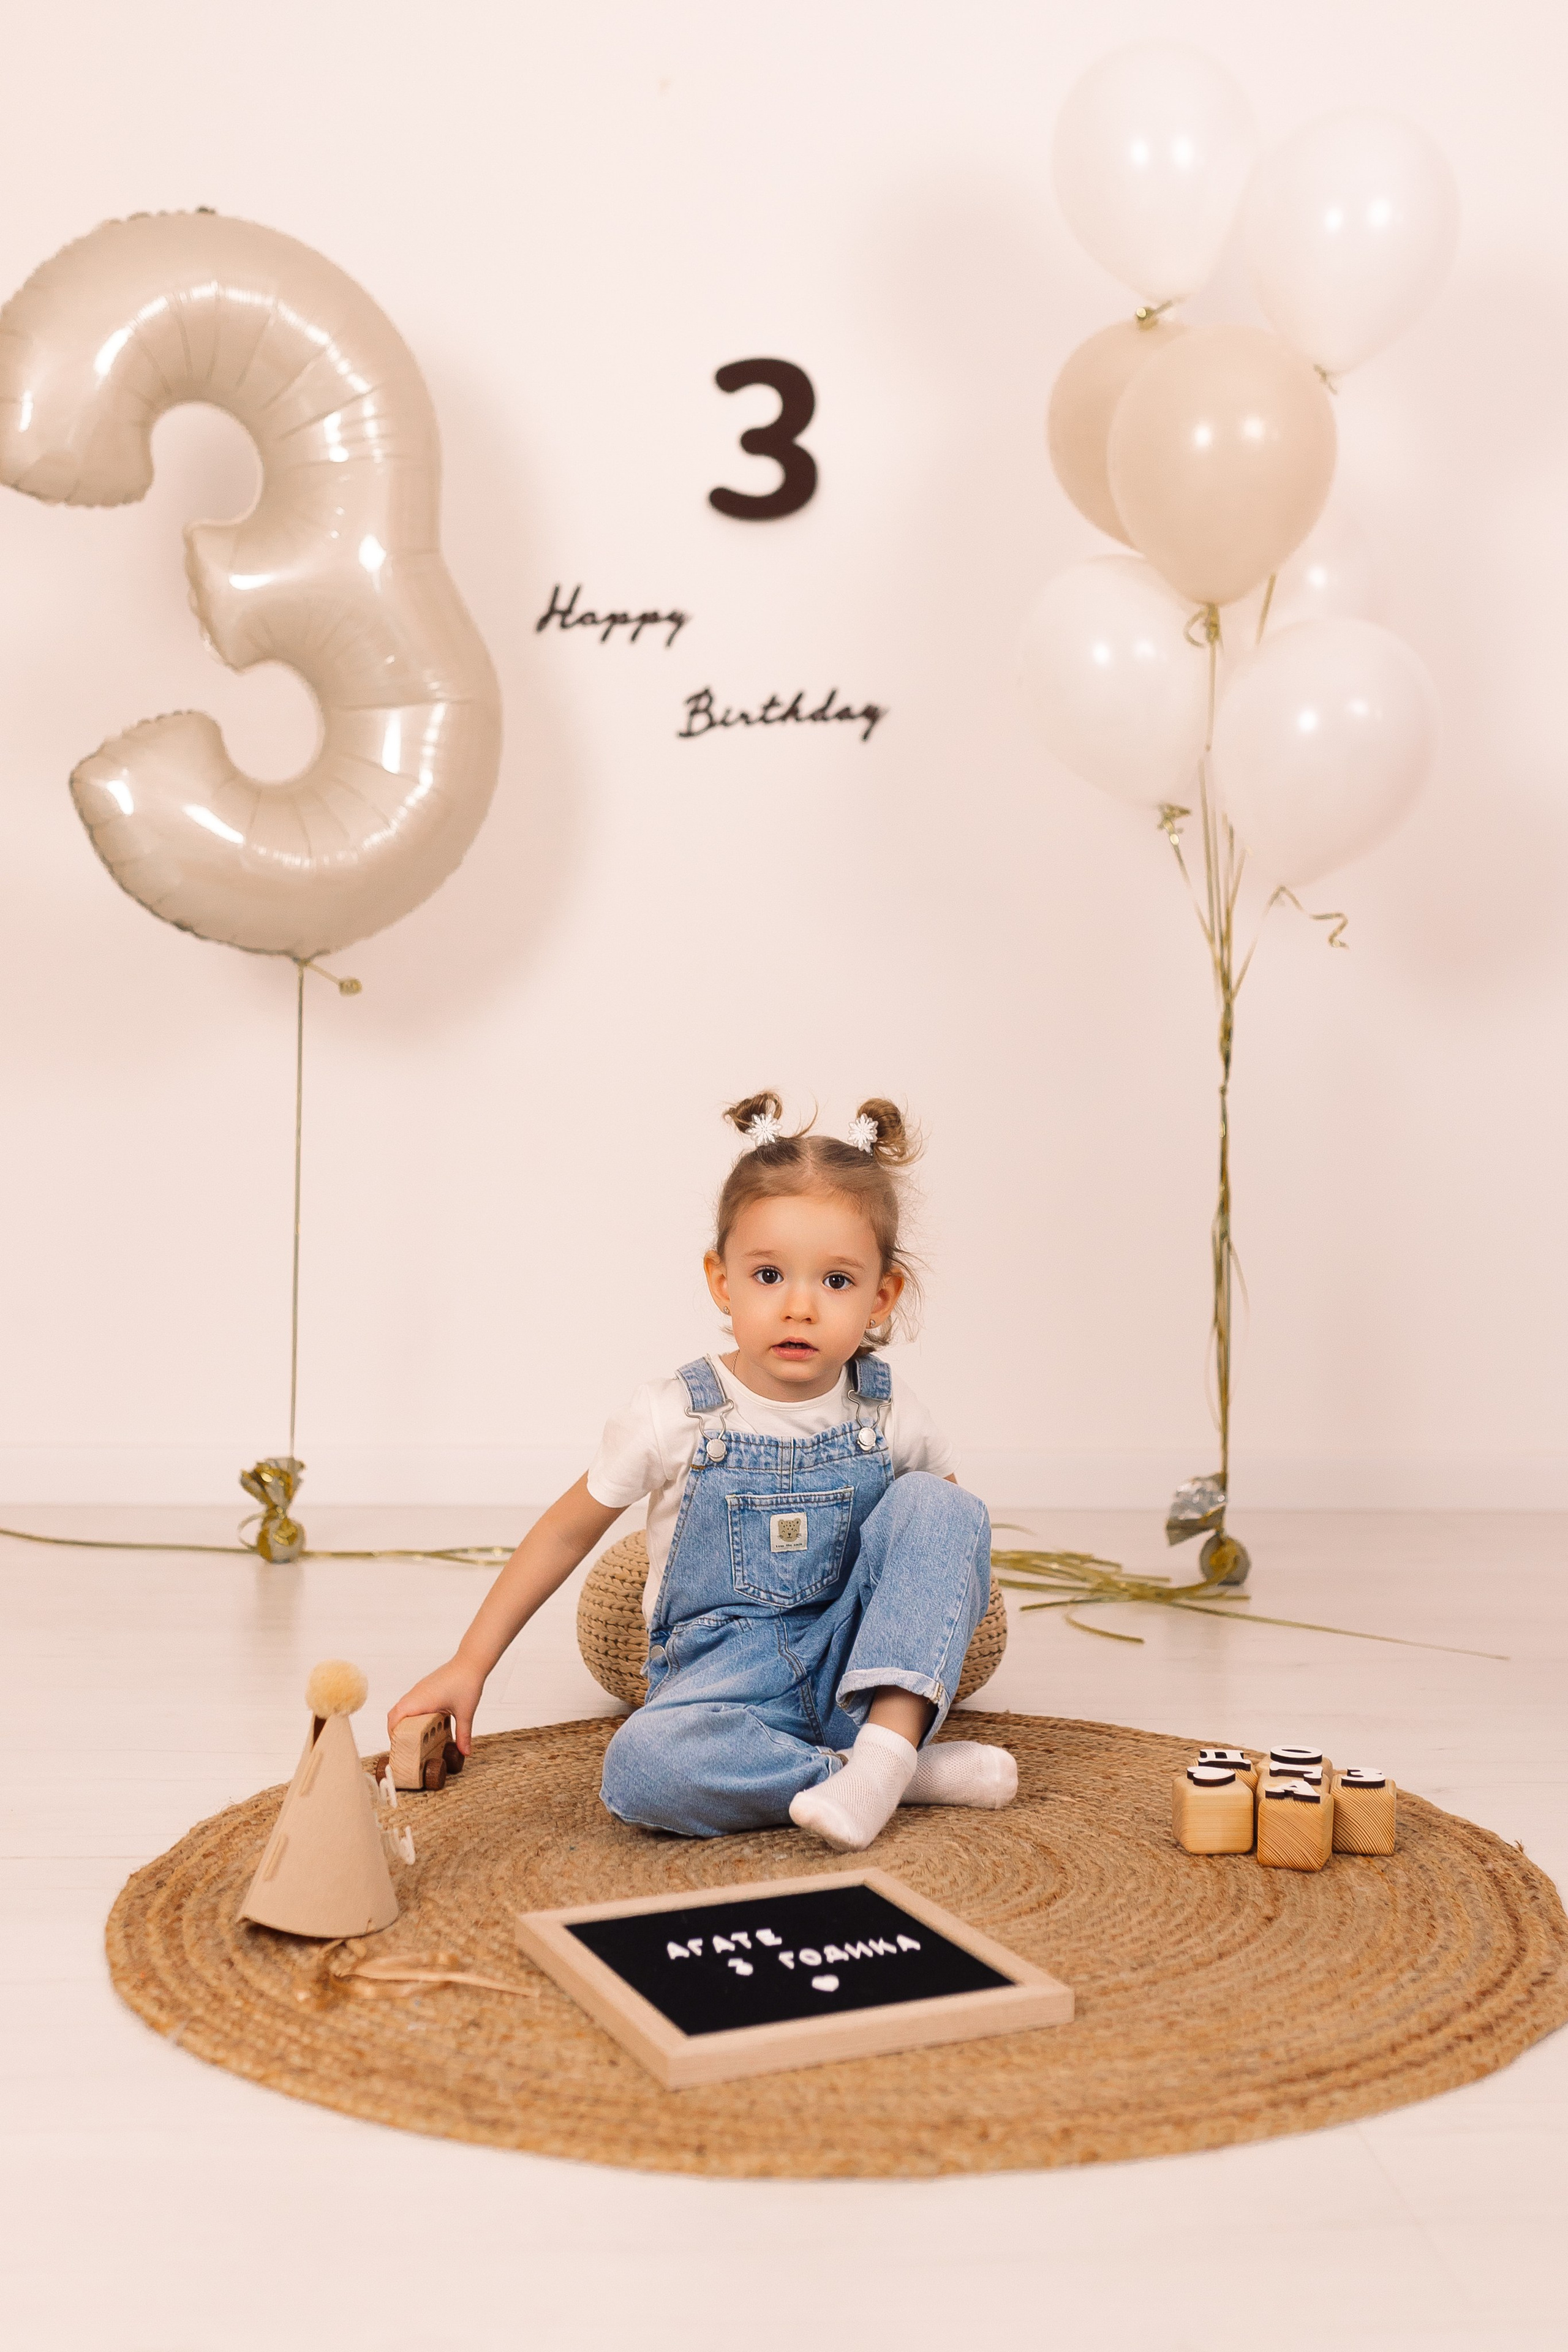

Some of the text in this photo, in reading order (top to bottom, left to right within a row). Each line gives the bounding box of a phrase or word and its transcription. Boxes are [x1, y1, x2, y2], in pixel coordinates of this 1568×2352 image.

[708, 358, 819, 523] 3
[0, 208, 502, 960] 3
[535, 584, 692, 647] Happy
[677, 686, 888, 742] Birthday
[778, 1934, 921, 1970] ГОДИКА
